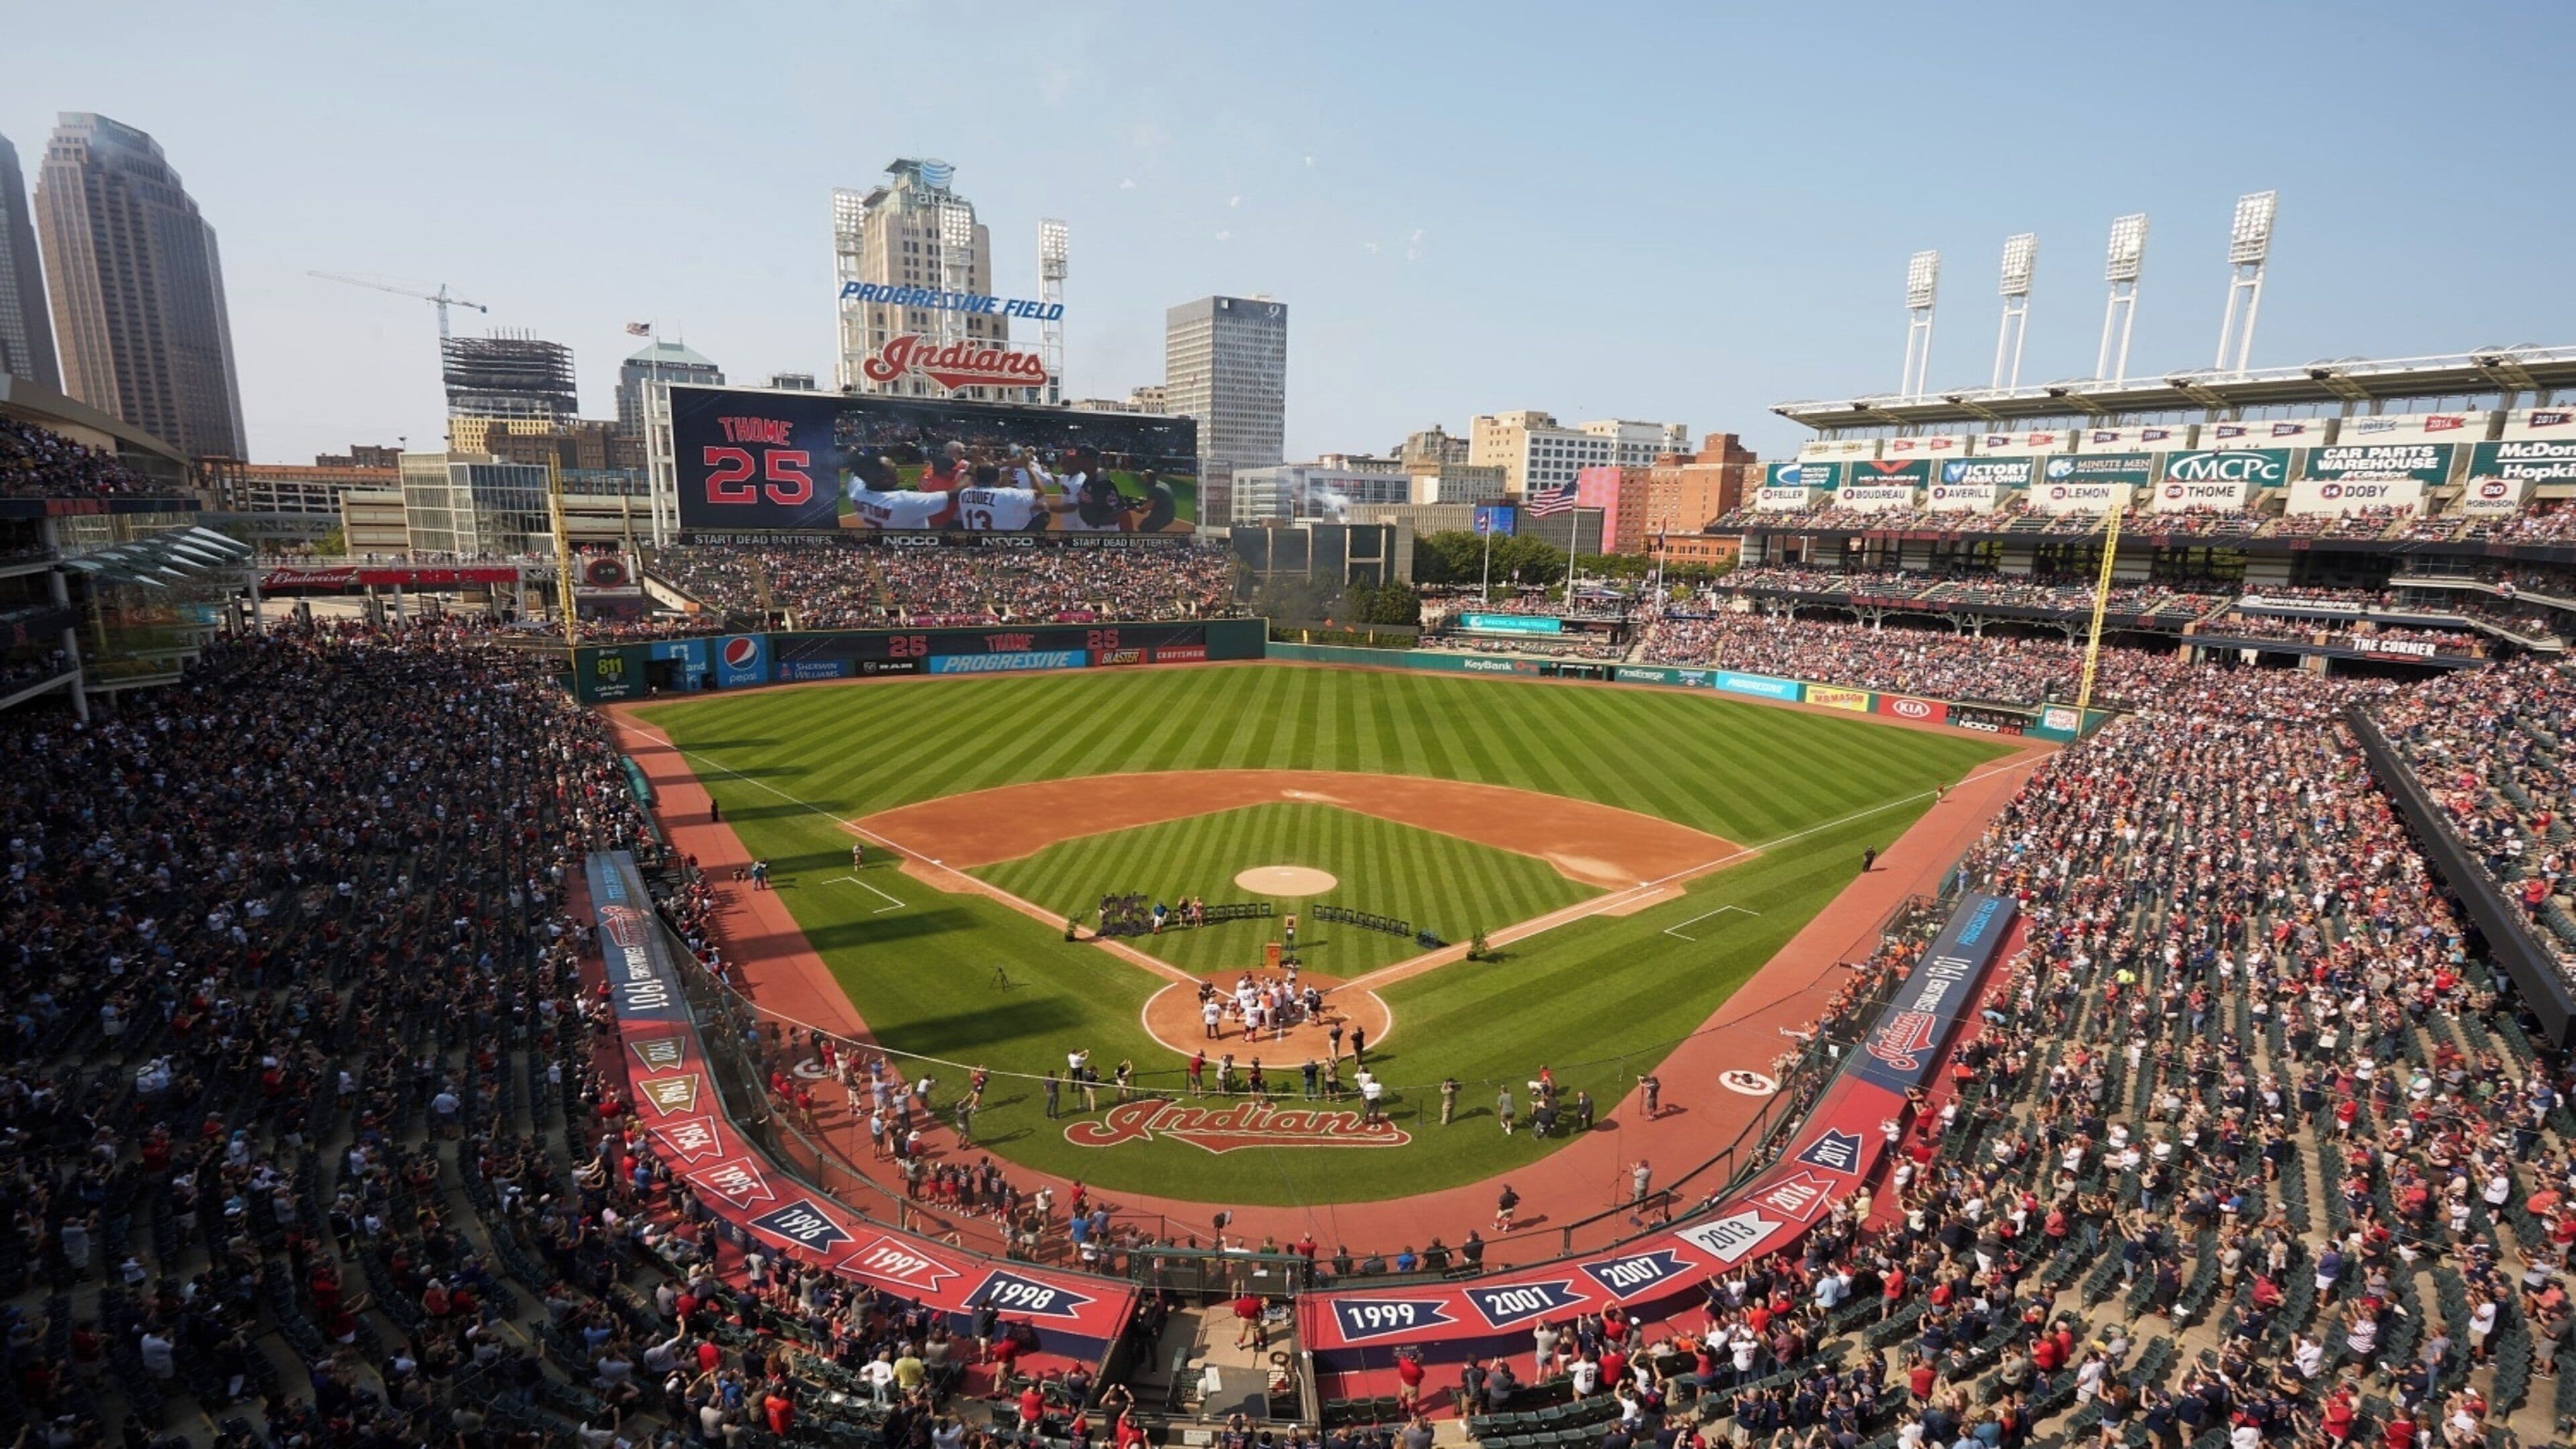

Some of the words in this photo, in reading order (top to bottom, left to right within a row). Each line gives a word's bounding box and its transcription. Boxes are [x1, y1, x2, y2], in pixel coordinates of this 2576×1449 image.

[840, 281, 1000, 314] PROGRESSIVE
[1002, 299, 1064, 321] FIELD
[863, 335, 1047, 389] Indians
[2534, 414, 2561, 424] 2017
[717, 417, 793, 445] THOME
[2323, 447, 2363, 459] CAR
[2367, 445, 2436, 459] PARTS
[1946, 461, 2031, 481] VICTORY
[2316, 458, 2440, 470] WAREHOUSE
[704, 446, 812, 504] 25
[1996, 475, 2027, 483] OHIO
[1774, 490, 1804, 499] FELLER
[1856, 490, 1906, 499] BOUDREAU
[1947, 488, 1991, 498] AVERILL
[2068, 488, 2110, 498] LEMON
[2188, 486, 2236, 498] THOME
[2344, 485, 2390, 498] DOBY
[2484, 485, 2505, 495] 20
[2466, 499, 2516, 508] ROBINSON
[695, 534, 732, 544] START
[736, 535, 769, 545] DEAD
[772, 535, 833, 545] BATTERIES
[883, 535, 939, 546] NOCO
[981, 537, 1034, 547] NOCO
[1073, 537, 1101, 547] START
[1104, 537, 1128, 547] DEAD
[272, 572, 349, 584] Budweiser
[889, 636, 928, 657] 25
[985, 634, 1034, 652] THOME
[1087, 629, 1120, 649] 25
[2351, 638, 2379, 651] THE
[2380, 640, 2436, 657] CORNER
[942, 651, 1073, 672] PROGRESSIVE
[1157, 650, 1205, 659] CRAFTSMAN
[597, 657, 623, 675] 811
[796, 662, 838, 671] SHERWIN
[1464, 659, 1512, 672] KeyBank
[729, 672, 757, 684] pepsi
[1898, 702, 1925, 715] KIA
[1959, 719, 1999, 733] NOCO
[1925, 955, 1972, 980] 1901
[623, 978, 670, 1010] 1901
[1866, 1010, 1937, 1071] Indians
[1064, 1098, 1412, 1154] Indians
[671, 1123, 712, 1150] 1954
[1814, 1139, 1854, 1168] 2017
[709, 1166, 759, 1195] 1995
[1766, 1181, 1818, 1212] 2016
[773, 1208, 833, 1241] 1996
[1698, 1220, 1757, 1251] 2013
[863, 1247, 930, 1278] 1997
[1600, 1256, 1663, 1288] 2007
[991, 1279, 1056, 1309] 1998
[1485, 1286, 1554, 1316] 2001
[1347, 1303, 1415, 1330] 1999
